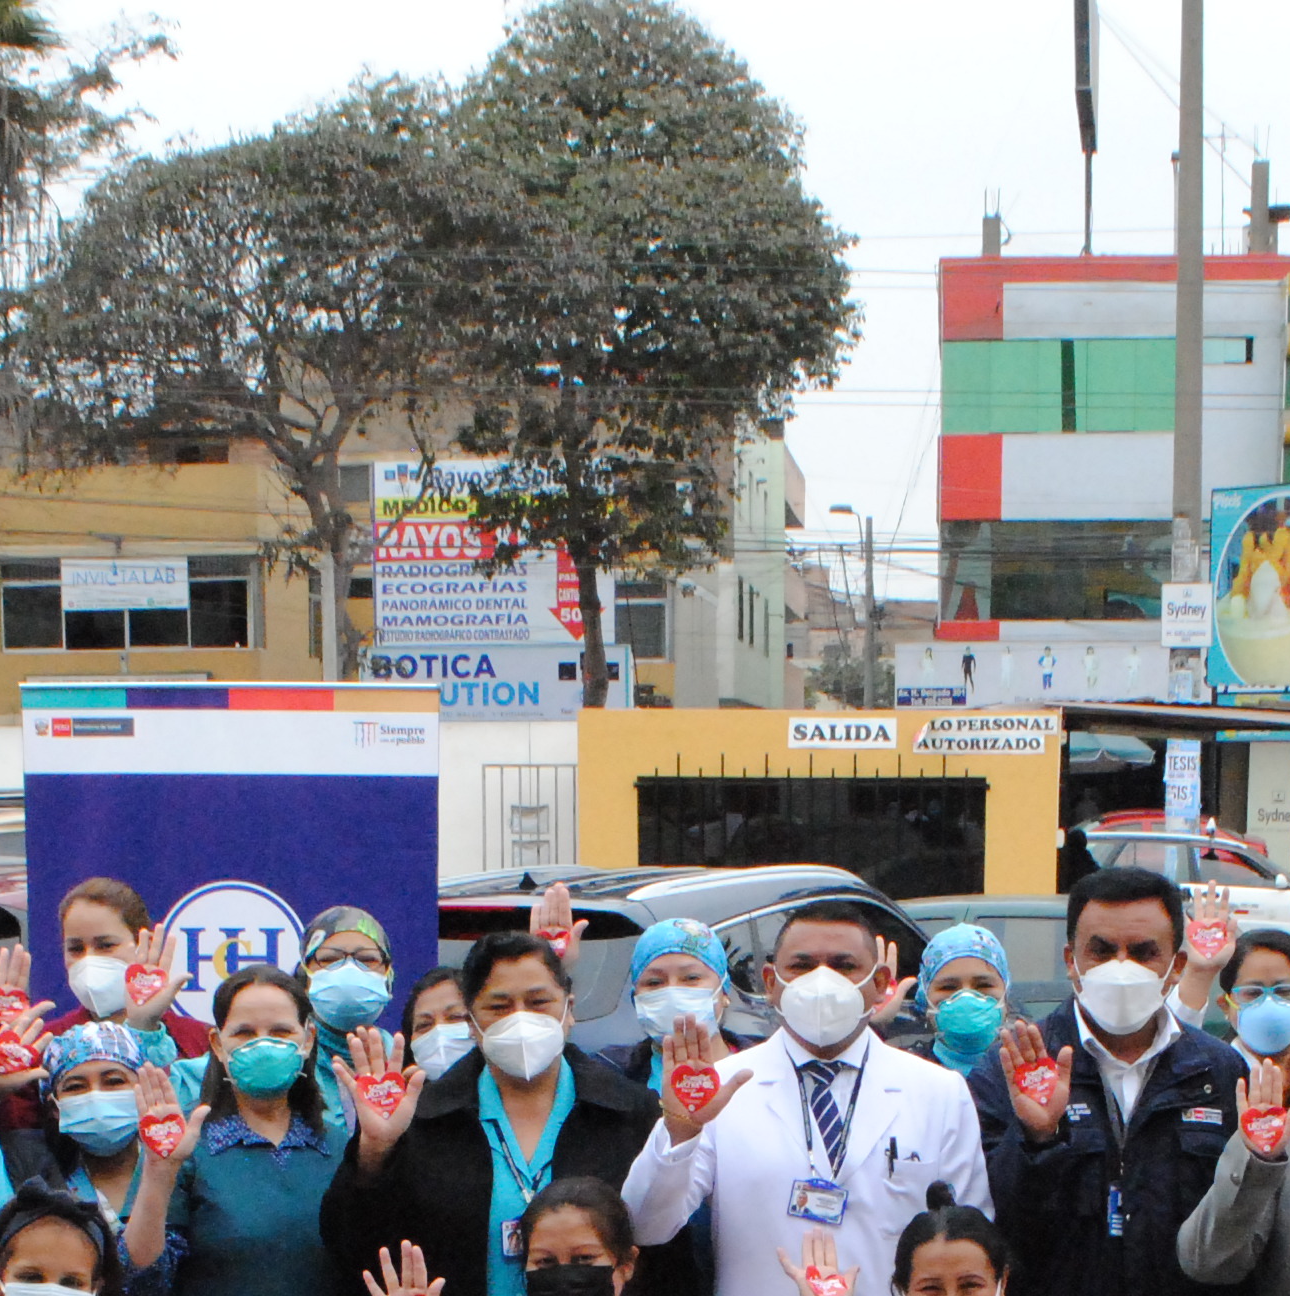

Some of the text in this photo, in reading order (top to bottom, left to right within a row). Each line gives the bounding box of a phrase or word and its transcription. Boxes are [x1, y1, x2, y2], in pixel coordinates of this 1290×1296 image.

[378, 525, 482, 559] RAYOS
[143, 566, 176, 584] LAB
[381, 579, 528, 595] ECOGRAFÍAS
[381, 597, 528, 612] PANORÁMICO DENTAL
[1167, 602, 1207, 619] Sydney
[382, 612, 529, 627] MAMOGRAFÍA
[473, 627, 530, 642] CONTRASTADO
[373, 653, 497, 679] BOTICA
[439, 681, 540, 707] UTION
[380, 724, 426, 738] Siempre
[792, 723, 892, 742] SALIDA
[958, 717, 1055, 732] PERSONAL
[916, 736, 1042, 751] AUTORIZADO
[1168, 755, 1197, 771] TESIS
